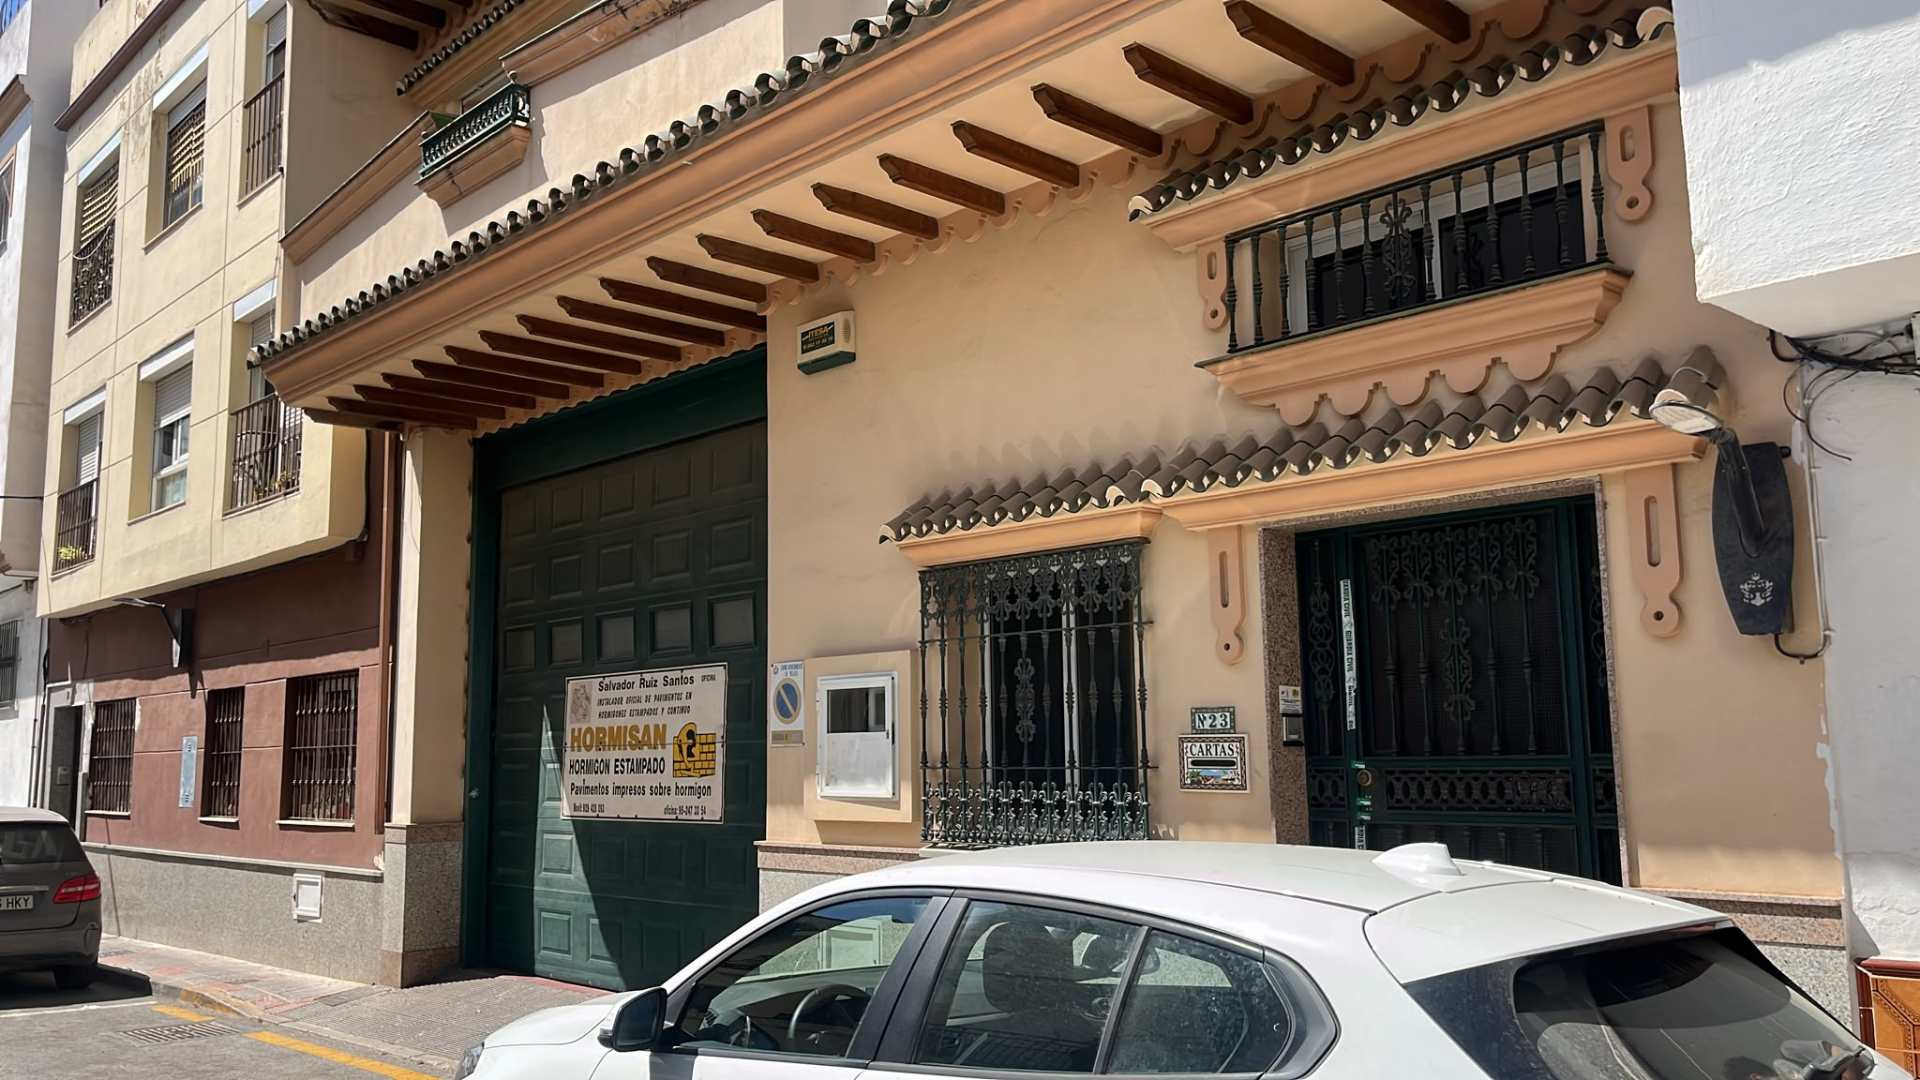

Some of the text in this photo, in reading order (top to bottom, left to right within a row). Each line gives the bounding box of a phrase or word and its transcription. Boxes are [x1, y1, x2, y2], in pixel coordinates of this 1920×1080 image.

[598, 679, 635, 692] Salvador
[639, 677, 658, 689] Ruiz
[663, 674, 695, 687] Santos
[645, 694, 653, 703] DE
[685, 691, 692, 701] EN
[629, 707, 659, 718] ESTAMPADOS
[661, 706, 665, 716] Y
[570, 723, 667, 752] HORMISAN
[1189, 743, 1235, 757] CARTAS
[569, 757, 666, 775] HORMIGON ESTAMPADO
[570, 781, 712, 799] Pavimentos impresos sobre hormigon
[6, 897, 30, 908] HKY
